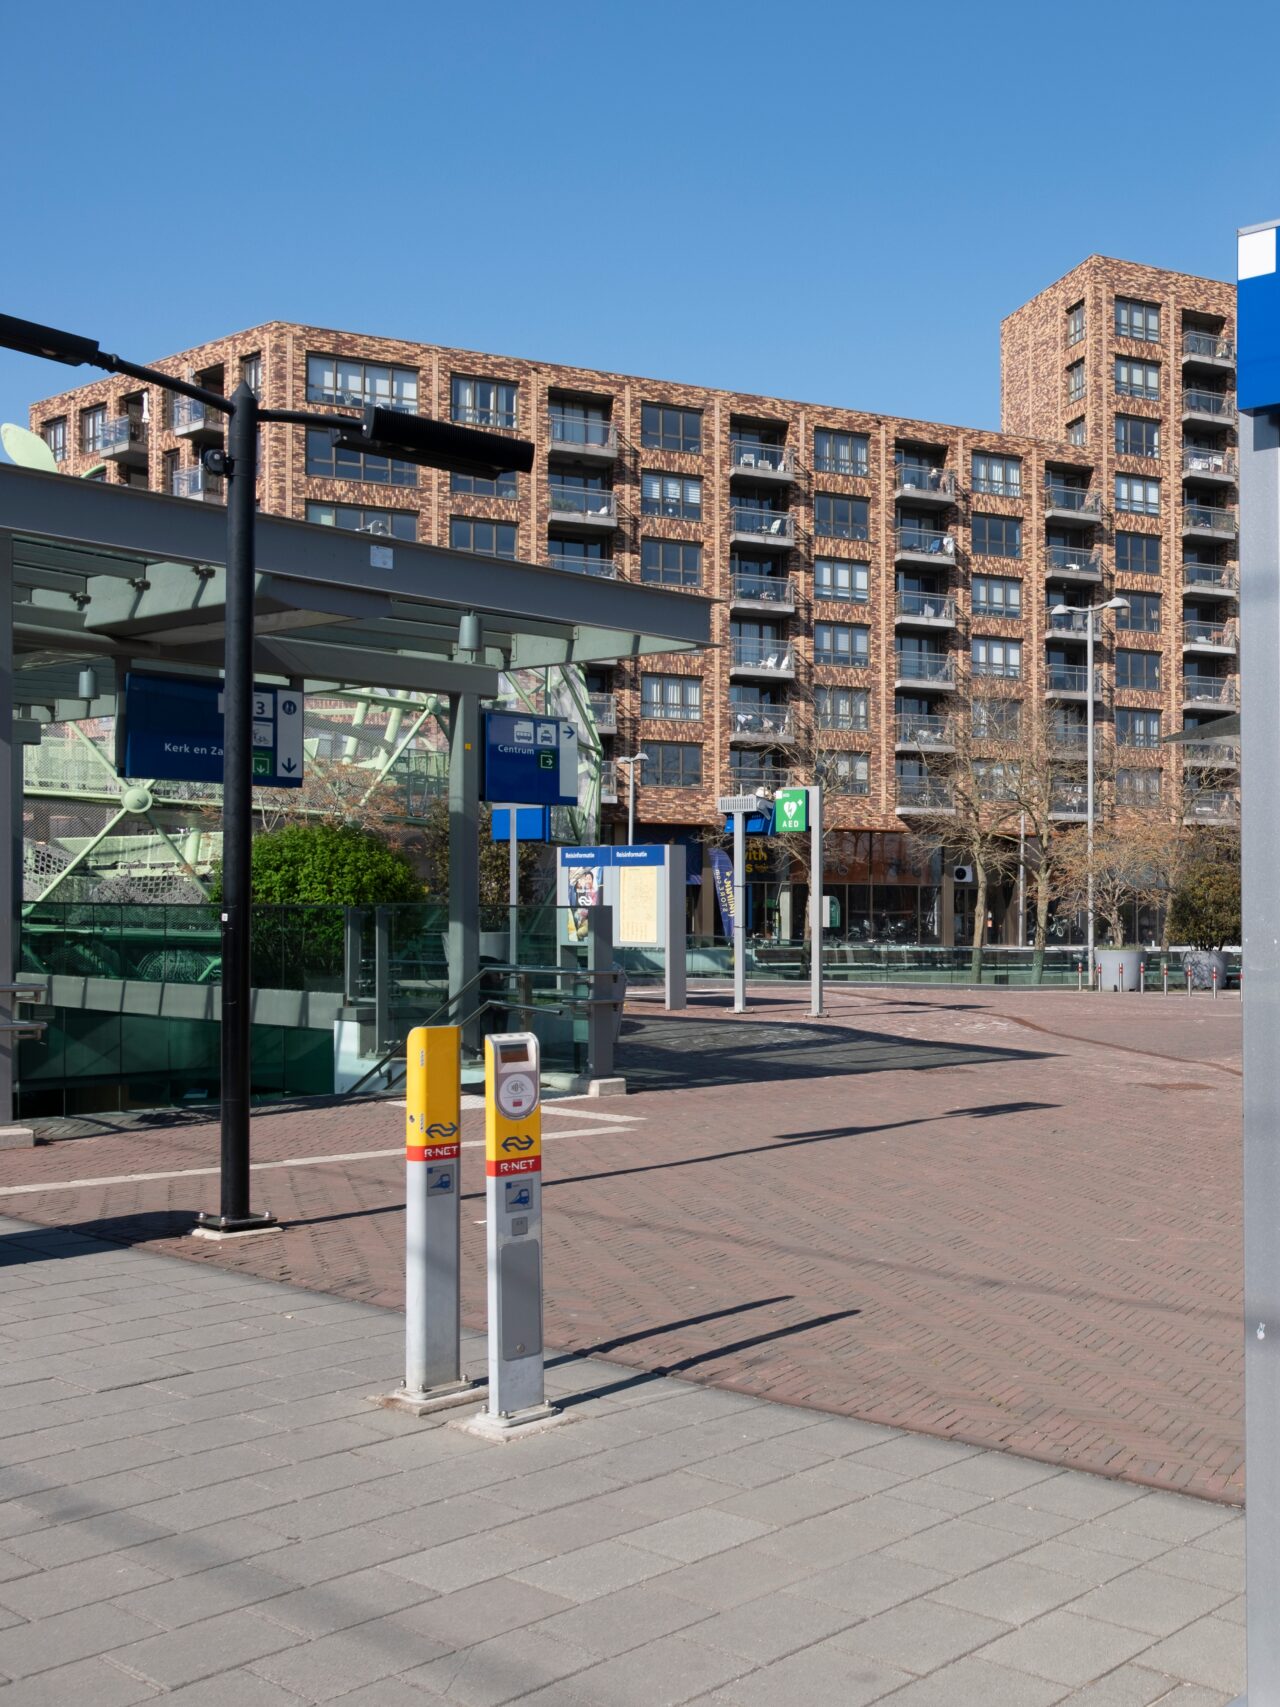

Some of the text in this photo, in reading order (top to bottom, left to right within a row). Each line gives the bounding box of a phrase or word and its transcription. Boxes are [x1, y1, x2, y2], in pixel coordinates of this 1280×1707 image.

[255, 701, 265, 715] 3
[164, 742, 225, 757] Kerk en Za
[497, 744, 535, 755] Centrum
[782, 820, 799, 828] AED
